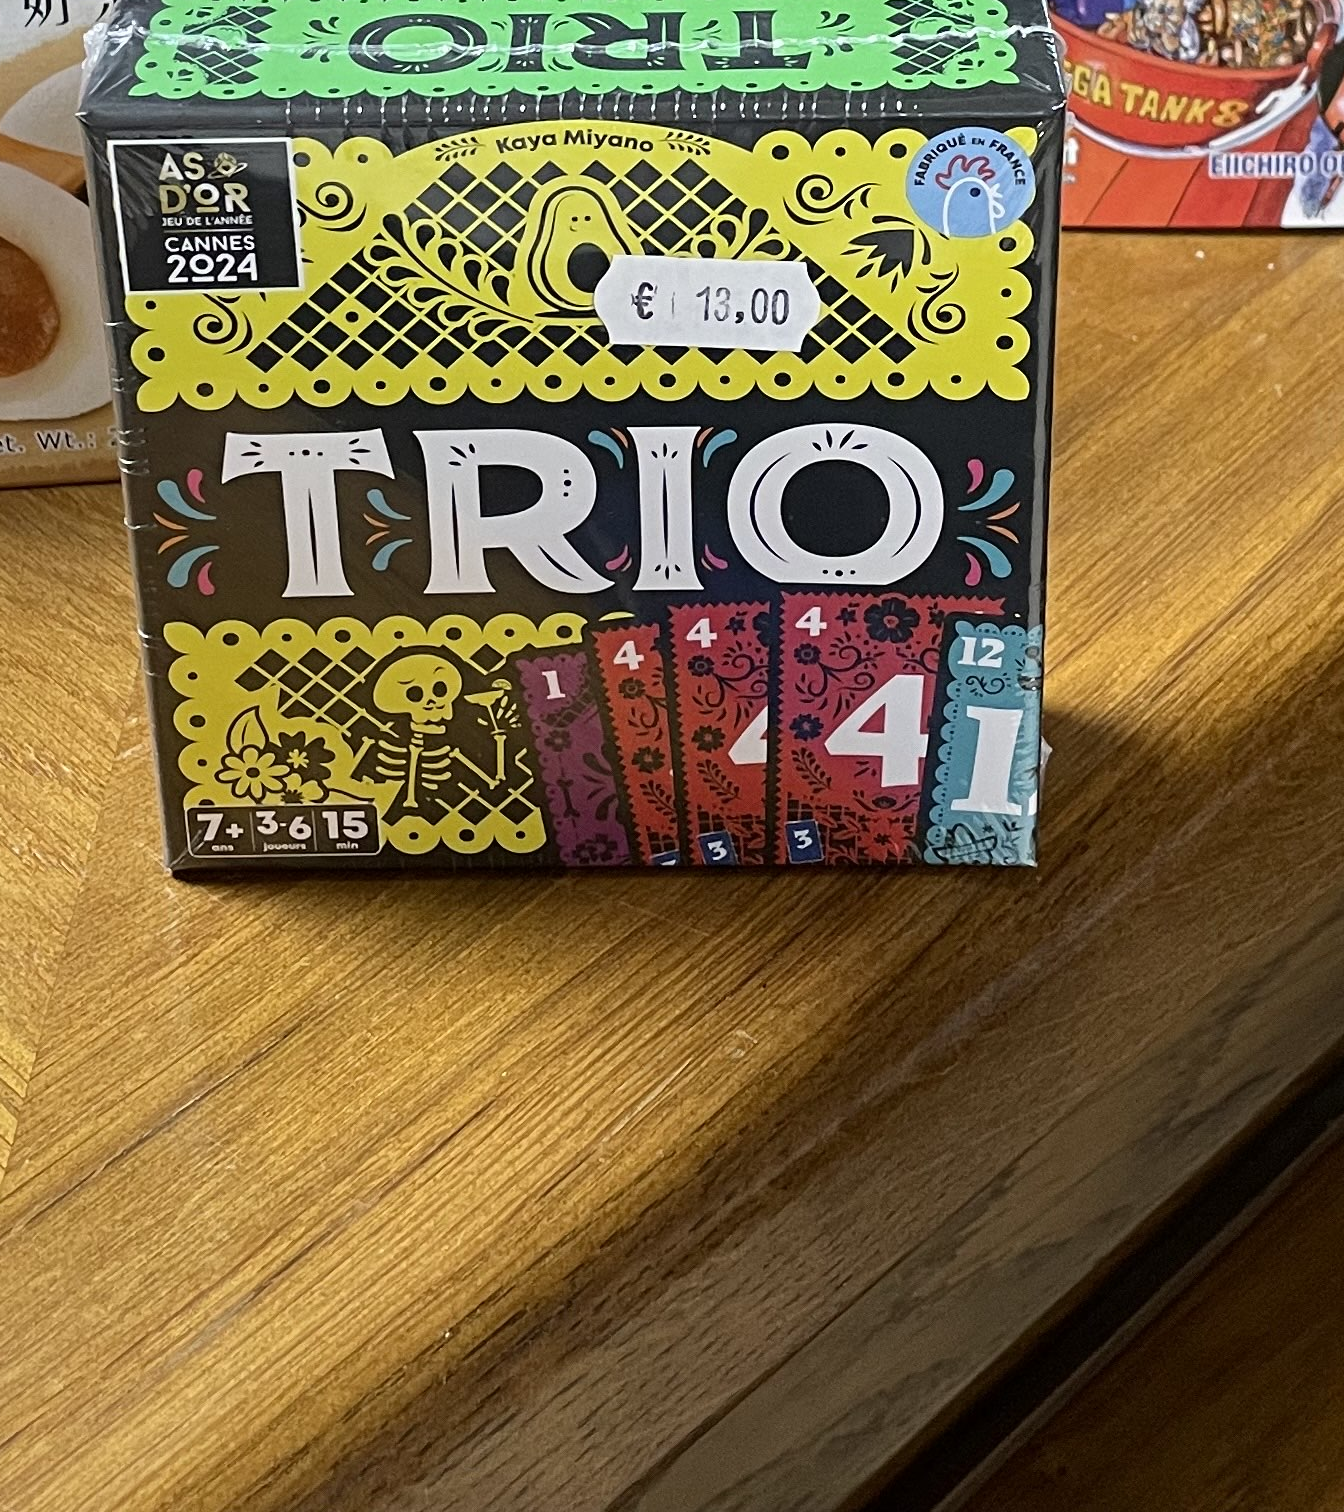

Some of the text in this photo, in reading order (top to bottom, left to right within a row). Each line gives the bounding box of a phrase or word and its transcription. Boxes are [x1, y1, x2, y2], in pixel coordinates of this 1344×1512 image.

[346, 8, 810, 78] TRIO
[1065, 61, 1113, 109] GA
[495, 128, 654, 154] Kaya Miyano
[159, 152, 206, 181] AS
[914, 133, 967, 186] FABRIQUÉ
[971, 137, 986, 146] EN
[988, 139, 1027, 186] FRANCE
[1210, 153, 1314, 176] EIICHIRO
[162, 214, 253, 227] JEU DE L'ANNÉE
[164, 235, 256, 253] CANNES
[166, 252, 258, 284] 2024
[695, 286, 790, 326] 13,00
[220, 420, 947, 600] TRIO
[686, 617, 718, 648] 4
[794, 605, 828, 637] 4
[613, 639, 646, 671] 4
[956, 636, 1007, 670] 12
[541, 670, 566, 701] 1
[823, 673, 930, 789] 4
[949, 705, 1035, 817] 1
[196, 810, 369, 842] 7+ 3-6 15
[793, 828, 813, 850] 3
[211, 841, 359, 853] ans joueurs min
[707, 841, 728, 860] 3
